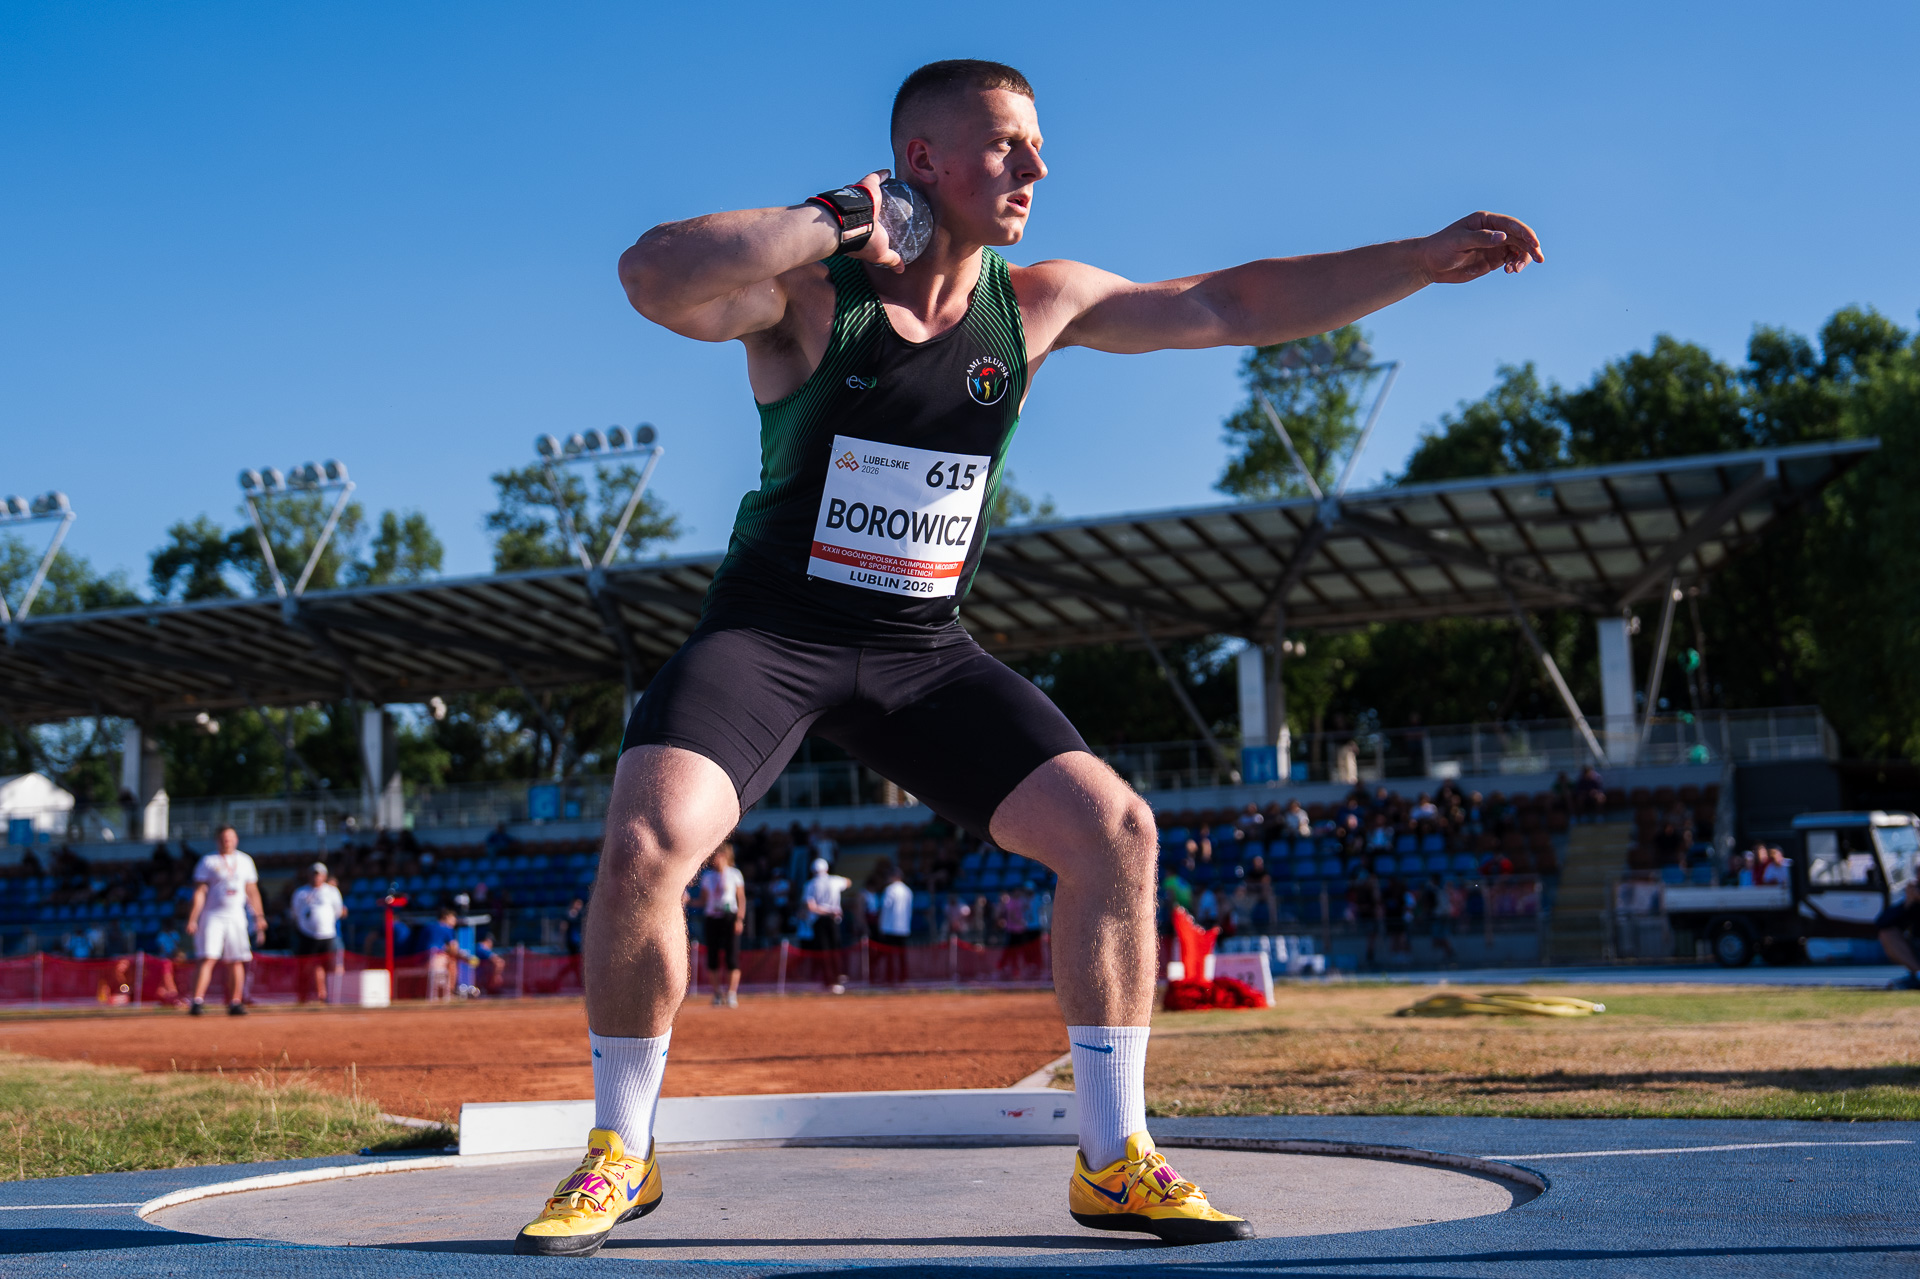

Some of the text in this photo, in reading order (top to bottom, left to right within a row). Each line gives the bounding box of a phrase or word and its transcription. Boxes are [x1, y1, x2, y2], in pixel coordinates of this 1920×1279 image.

[966, 358, 982, 376] AML
[861, 465, 879, 475] 2026
[863, 454, 910, 470] LUBELSKIE
[925, 461, 977, 491] 615
[825, 497, 972, 546] BOROWICZ
[822, 545, 841, 554] XXXII
[841, 549, 898, 565] OGÓLNOPOLSKA
[899, 559, 934, 569] OLIMPIADA
[868, 562, 906, 574] SPORTACH
[907, 568, 933, 577] LETNICH
[849, 570, 934, 593] LUBLIN 2026
[590, 1148, 605, 1156] NIKE
[559, 1172, 606, 1196] NIKE
